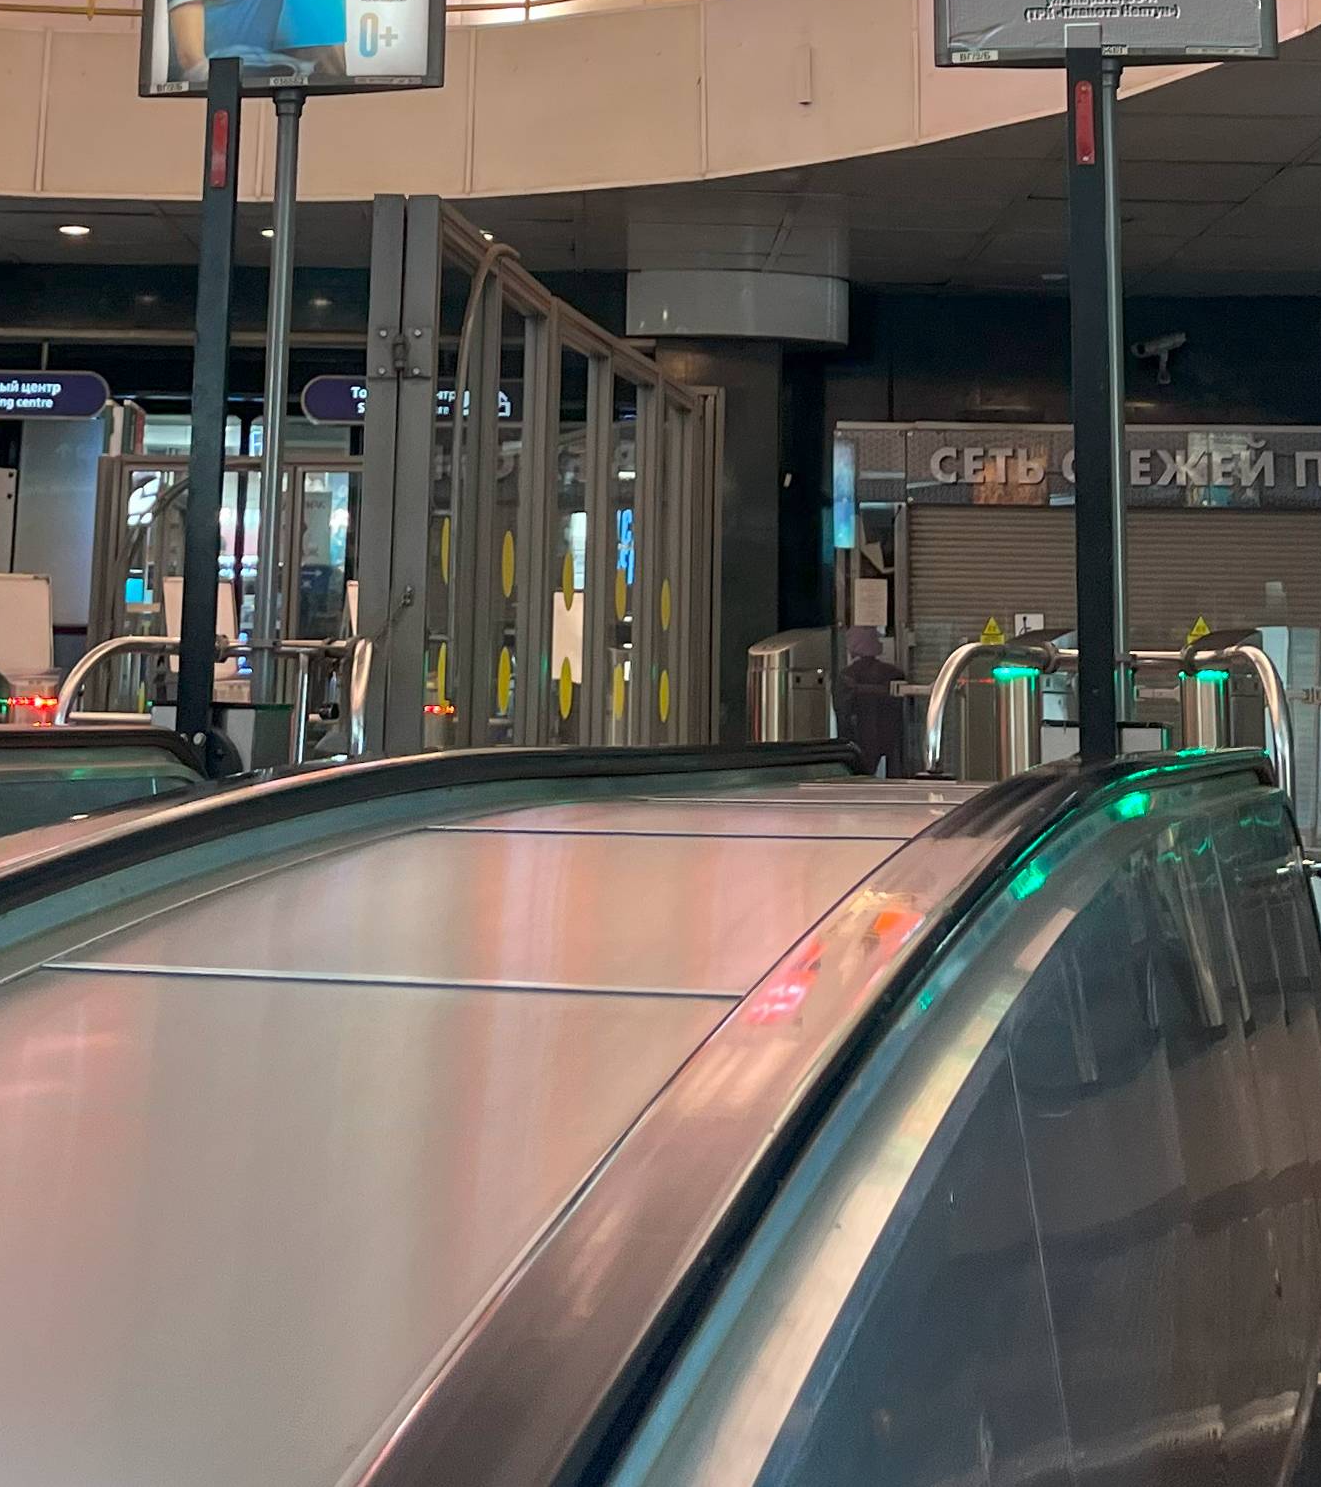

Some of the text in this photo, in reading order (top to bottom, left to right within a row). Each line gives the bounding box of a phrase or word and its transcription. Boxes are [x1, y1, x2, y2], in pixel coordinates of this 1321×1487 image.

[359, 13, 398, 58] 0+
[21, 381, 62, 396] центр
[16, 397, 54, 409] centre
[930, 446, 1045, 485] СЕТЬ
